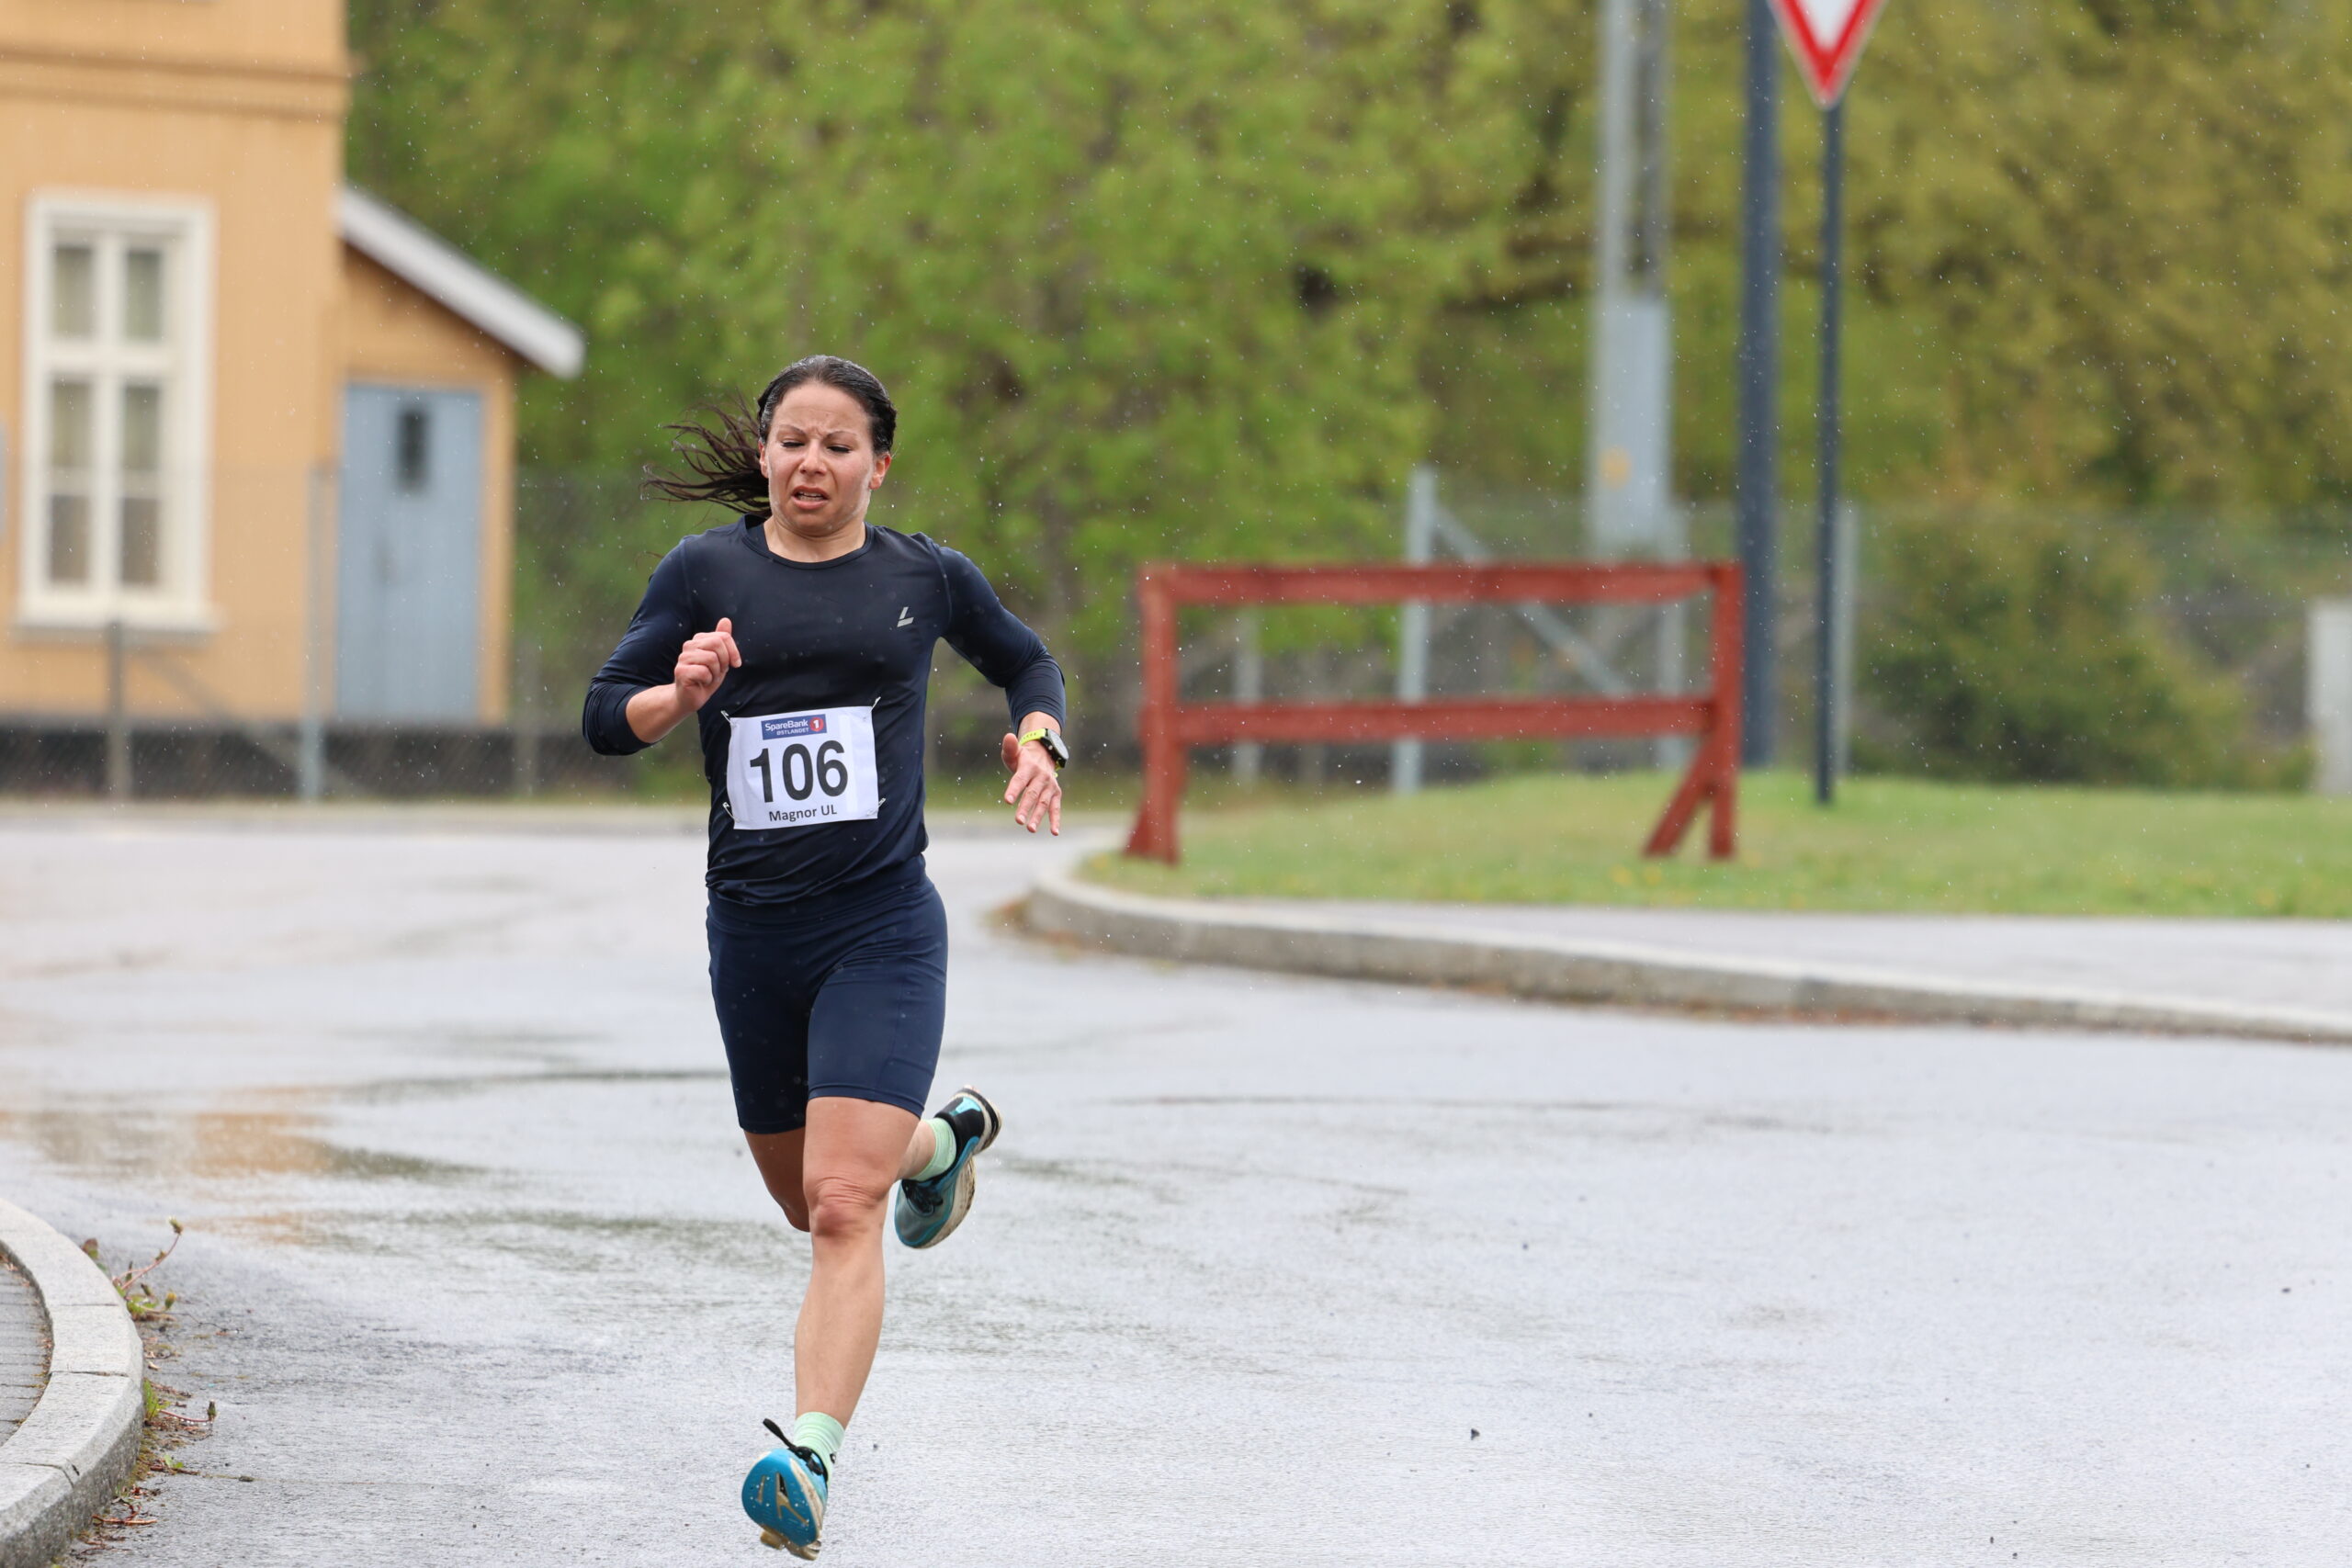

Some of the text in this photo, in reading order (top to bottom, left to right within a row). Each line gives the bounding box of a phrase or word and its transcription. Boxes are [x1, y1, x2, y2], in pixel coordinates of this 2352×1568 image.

[764, 719, 820, 732] SpareBank 1
[776, 727, 808, 736] ØSTLANDET
[750, 739, 848, 803] 106
[769, 804, 837, 822] Magnor UL
